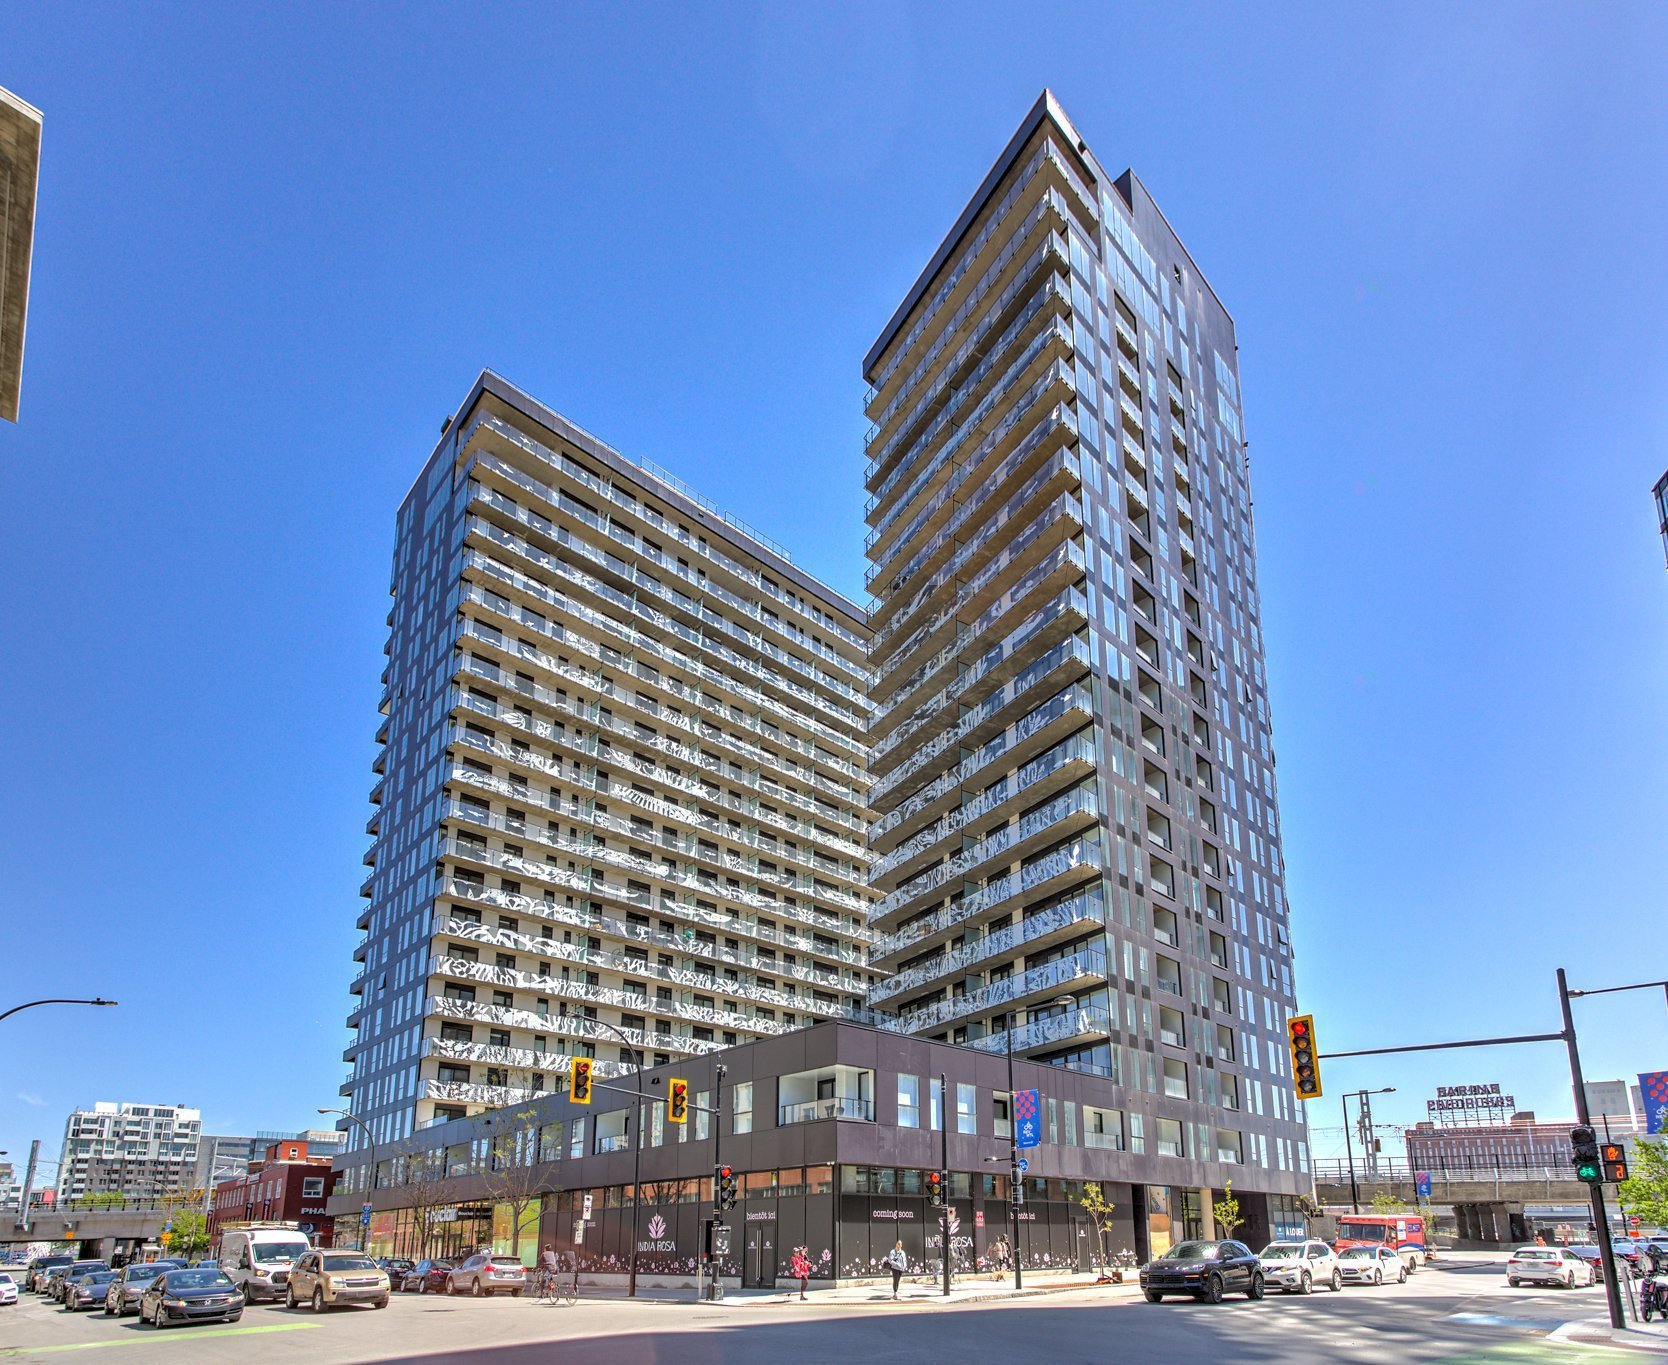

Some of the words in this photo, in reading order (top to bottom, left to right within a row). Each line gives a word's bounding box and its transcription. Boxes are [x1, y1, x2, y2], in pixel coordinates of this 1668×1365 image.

[872, 1209, 898, 1220] coming
[637, 1241, 656, 1252] INDIA
[656, 1240, 676, 1252] ROSA
[925, 1236, 945, 1248] INDI
[950, 1236, 974, 1248] ROSA
